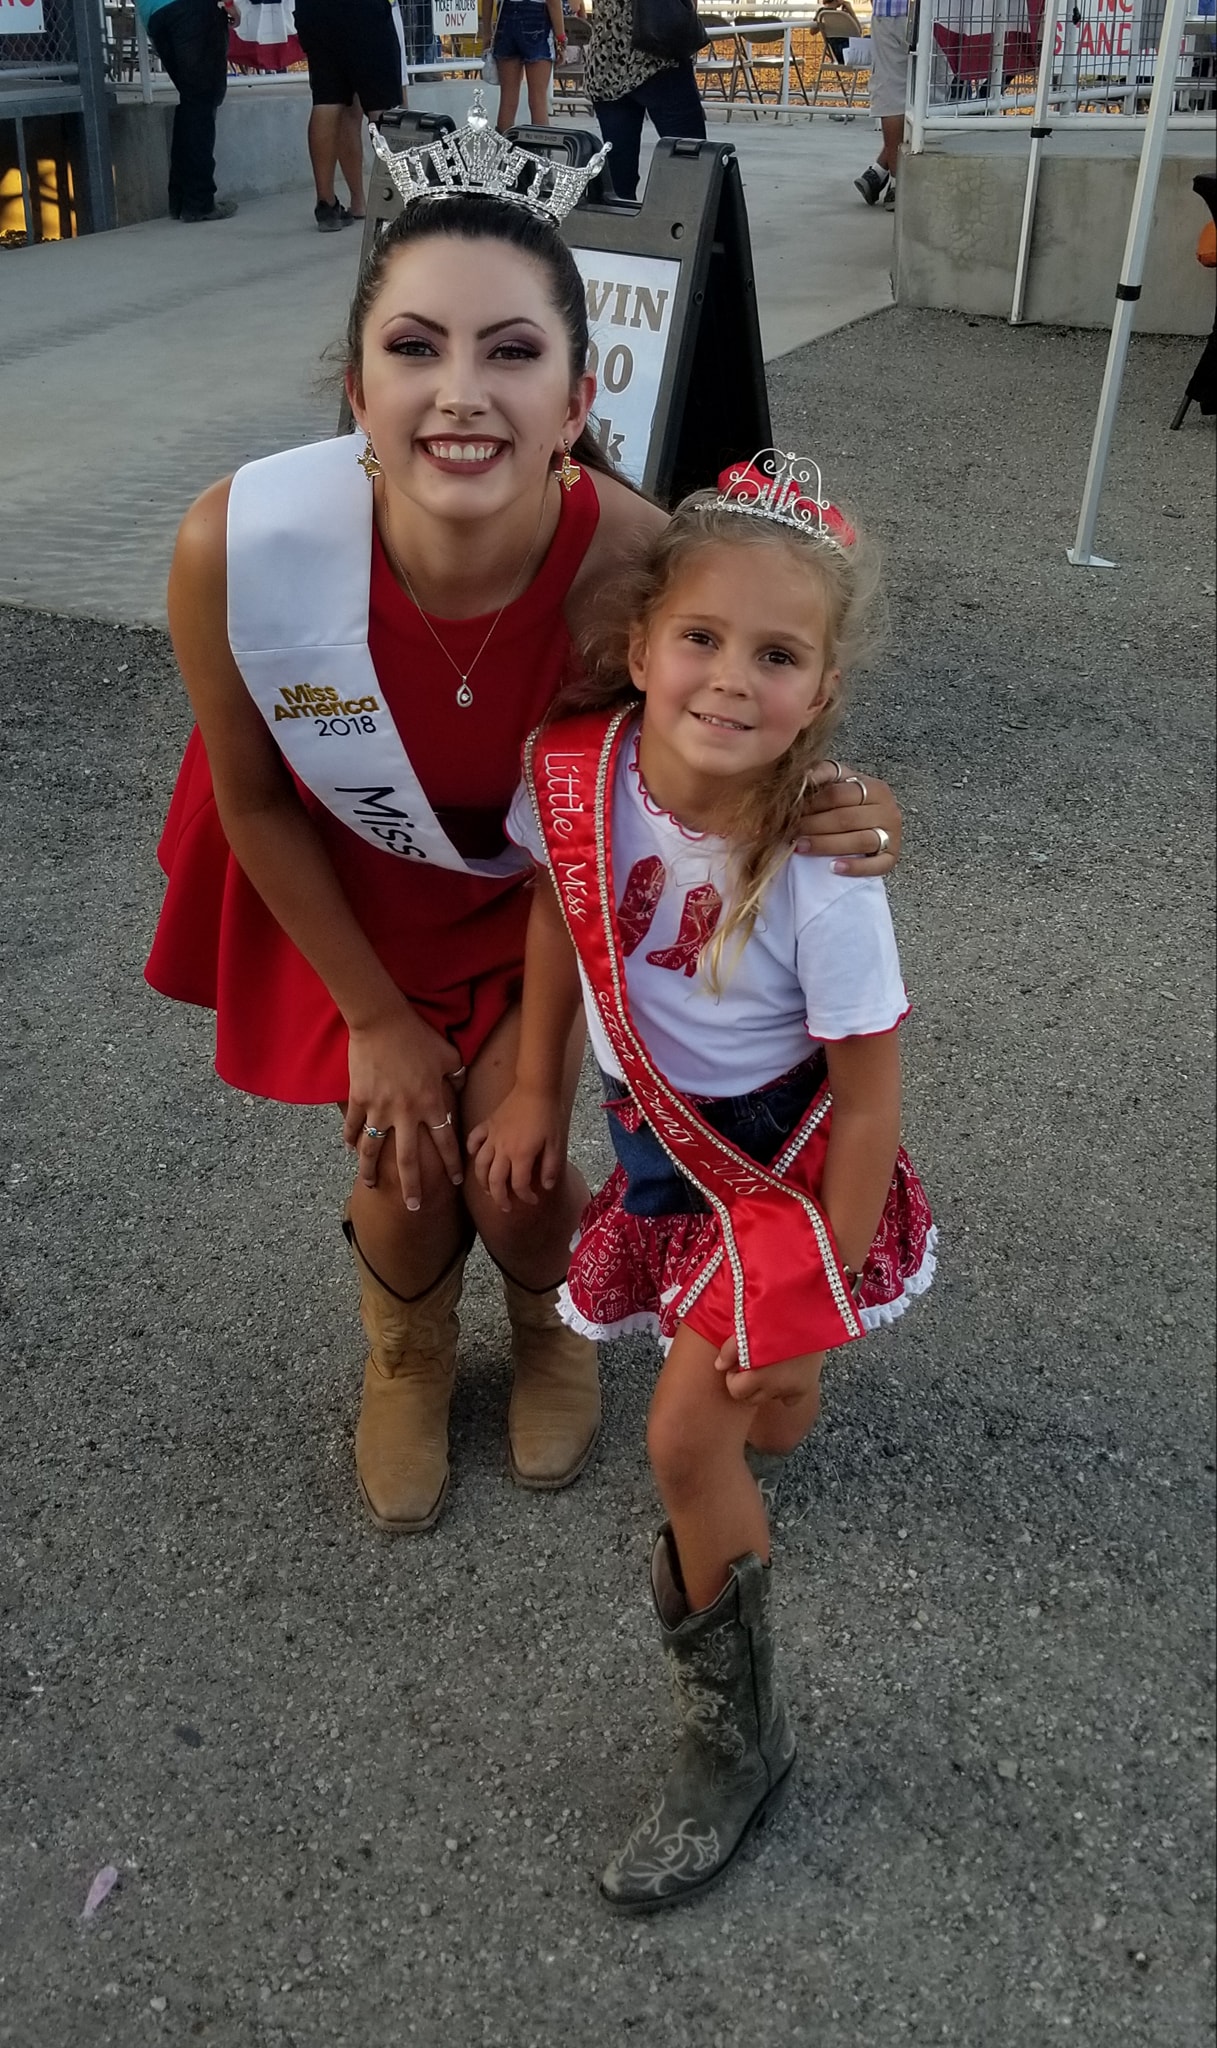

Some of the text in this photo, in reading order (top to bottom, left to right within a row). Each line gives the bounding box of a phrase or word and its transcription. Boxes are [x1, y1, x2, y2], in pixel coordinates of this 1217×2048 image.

[445, 13, 467, 27] ONLY
[274, 695, 380, 722] America
[279, 682, 339, 705] Miss
[314, 715, 377, 737] 2018
[544, 752, 585, 840] Little
[334, 786, 427, 859] Miss
[558, 861, 588, 924] Miss
[635, 1079, 698, 1147] County
[699, 1159, 769, 1196] 2018
